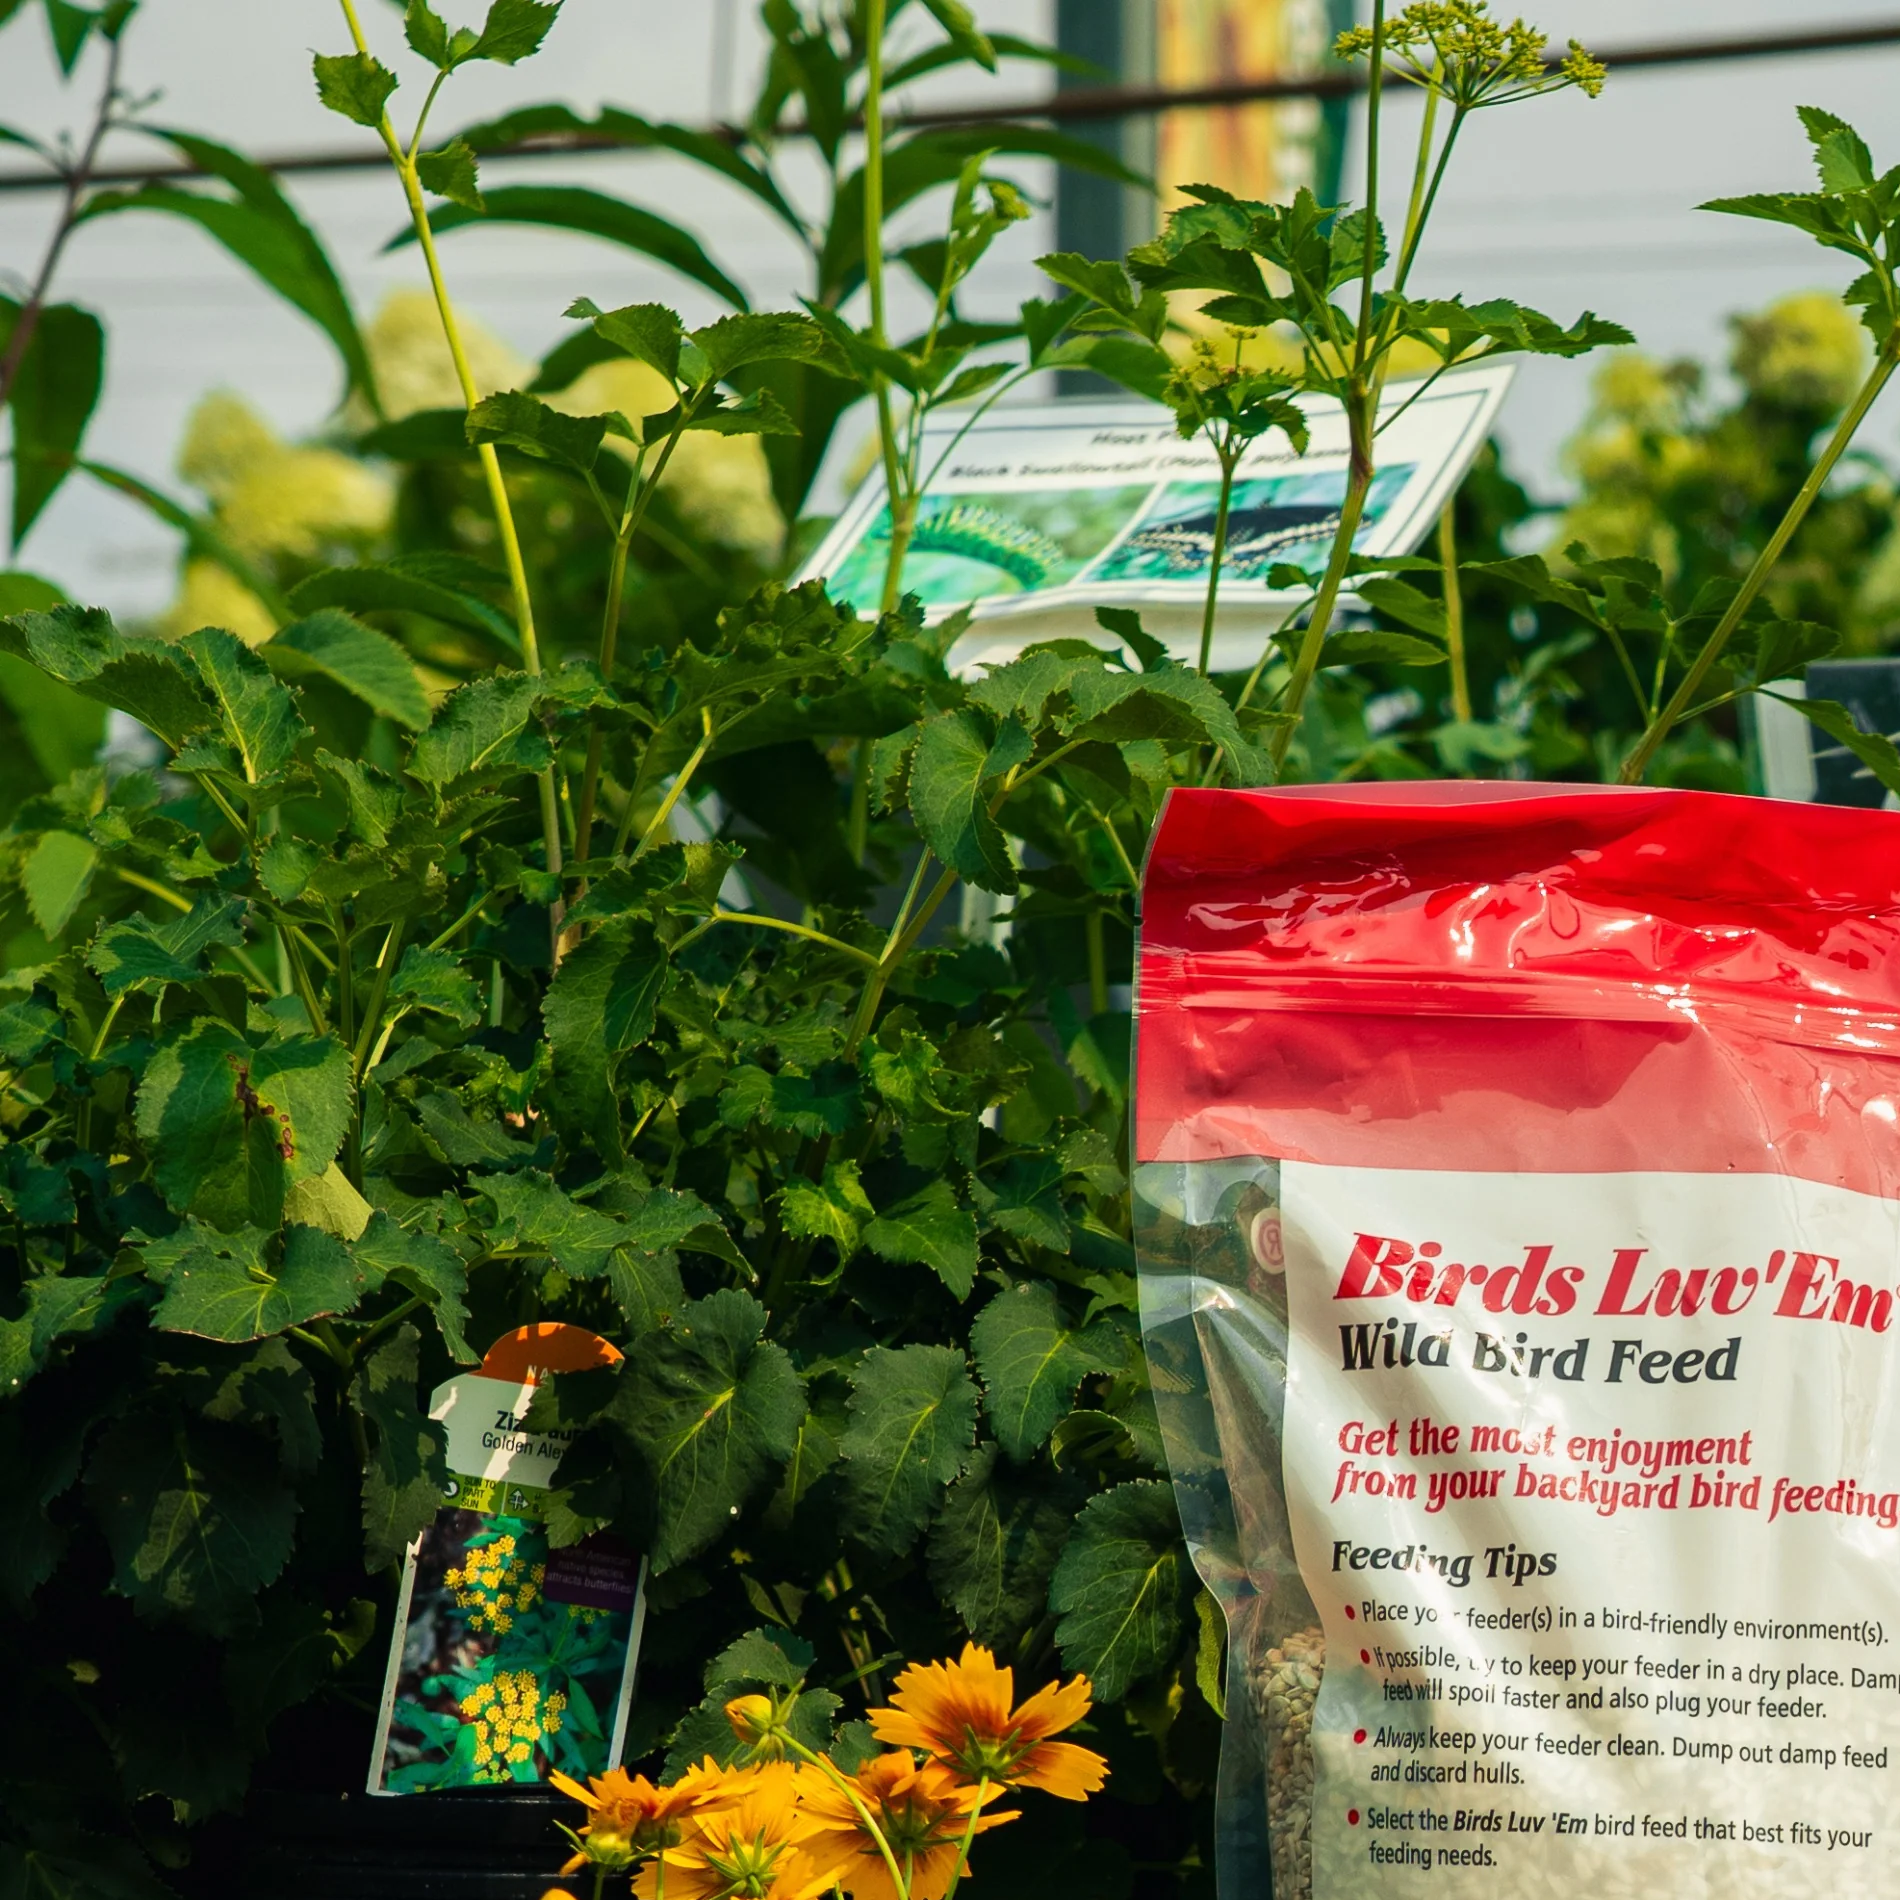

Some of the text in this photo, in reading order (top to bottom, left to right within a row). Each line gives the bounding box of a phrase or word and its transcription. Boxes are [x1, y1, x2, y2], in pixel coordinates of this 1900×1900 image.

[1332, 1231, 1585, 1316] Birds
[1339, 1317, 1742, 1384] Wild Bird Feed
[482, 1431, 533, 1455] Golden
[1338, 1416, 1752, 1478] Get the most enjoyment
[460, 1497, 479, 1509] SUN
[462, 1487, 485, 1499] PART
[464, 1476, 497, 1490] SUN TO
[1331, 1459, 1418, 1503] from
[1426, 1469, 1502, 1513] your
[1515, 1463, 1678, 1516] backyard
[1688, 1471, 1761, 1511] bird
[1331, 1540, 1558, 1588] Feeding Tips
[1373, 1725, 1888, 1770] Always keep your feeder clean. Dump out damp feed
[1371, 1759, 1525, 1784] and discard hulls.
